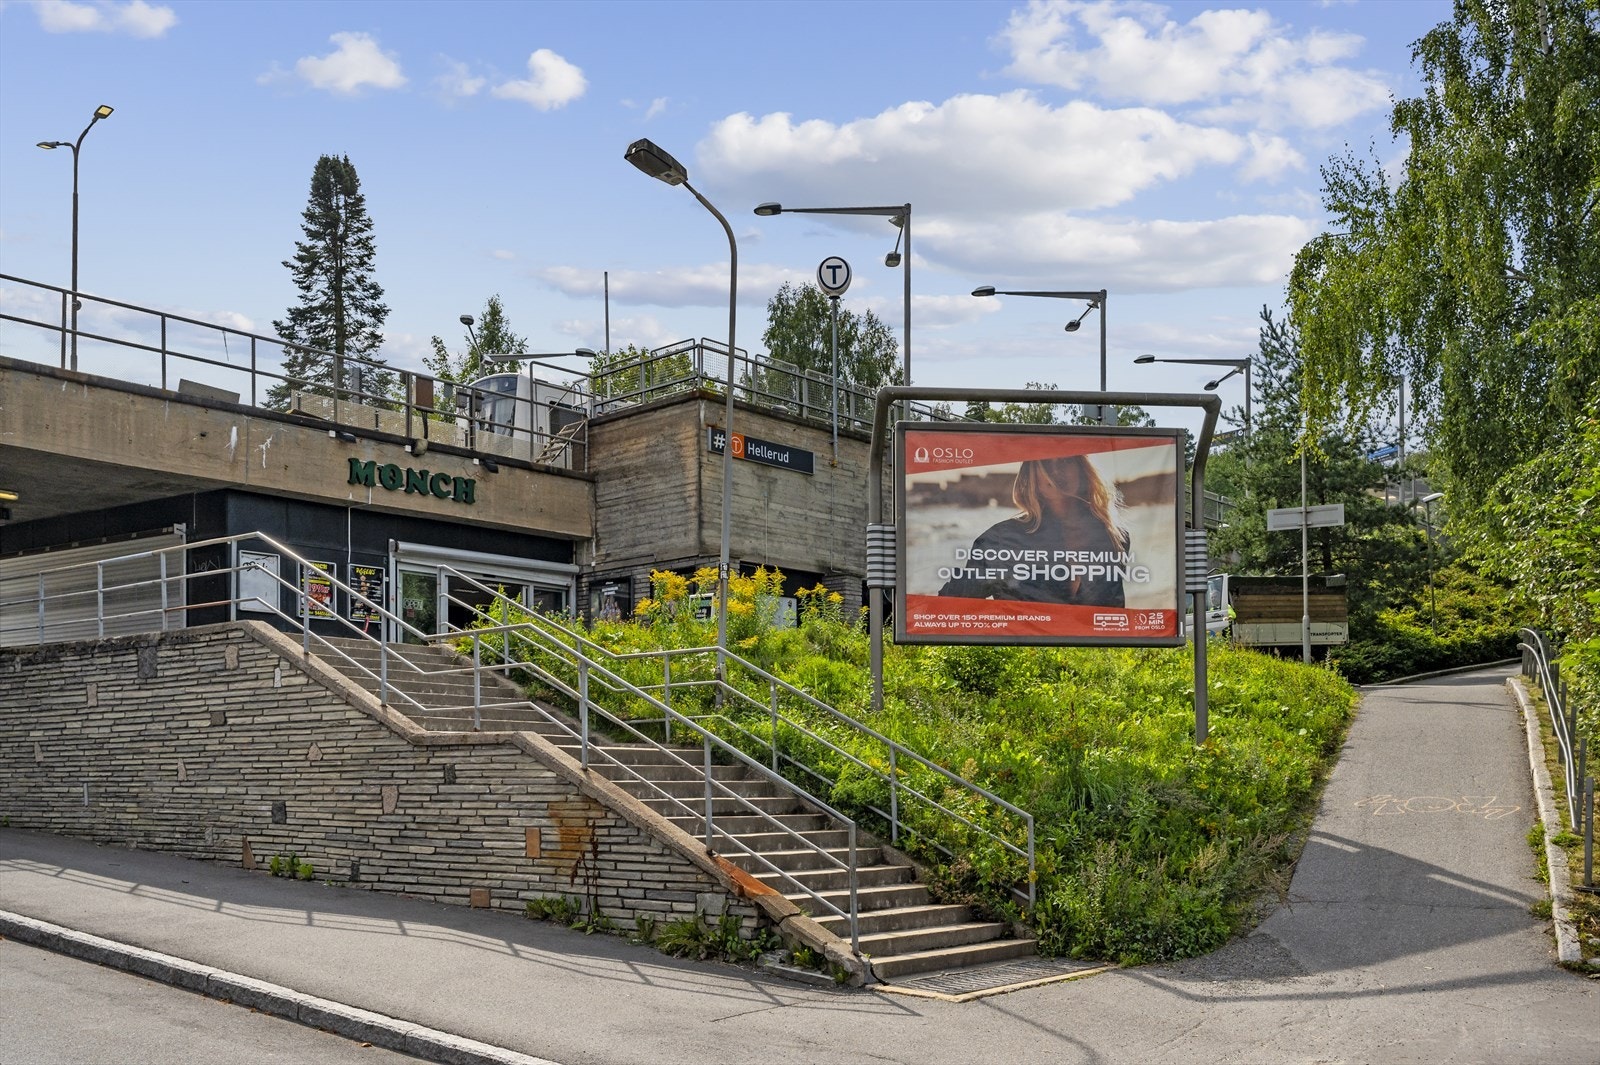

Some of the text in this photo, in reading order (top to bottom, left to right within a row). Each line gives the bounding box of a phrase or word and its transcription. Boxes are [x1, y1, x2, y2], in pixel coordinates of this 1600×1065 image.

[826, 264, 842, 284] T
[747, 442, 789, 463] Hellerud
[932, 447, 974, 459] OSLO
[955, 549, 1136, 563] DISCOVER PREMIUM
[937, 564, 1150, 583] OUTLET SHOPPING
[913, 613, 936, 621] SHOP
[1148, 612, 1164, 620] 25
